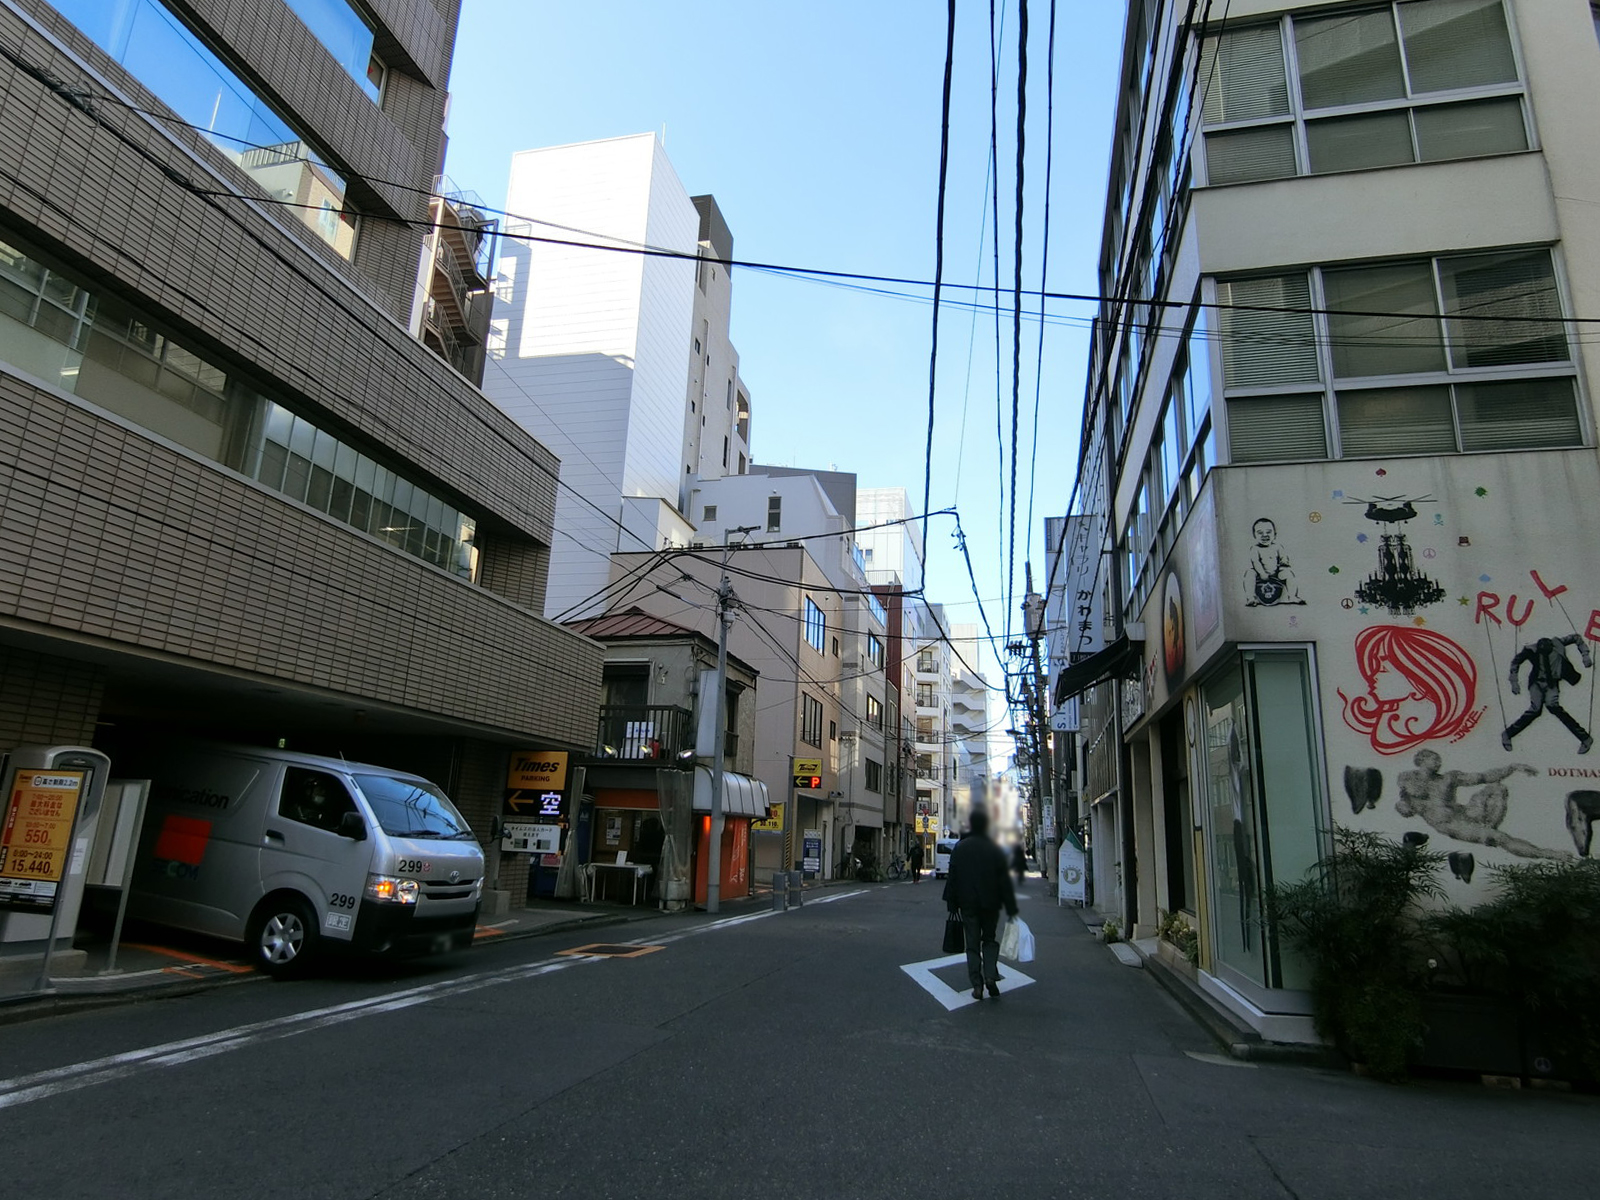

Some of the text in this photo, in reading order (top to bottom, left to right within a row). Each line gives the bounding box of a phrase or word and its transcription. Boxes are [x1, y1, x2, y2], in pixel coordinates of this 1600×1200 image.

[514, 757, 560, 773] Times
[811, 777, 820, 788] P
[539, 791, 562, 815] 空
[398, 859, 423, 873] 299
[330, 892, 356, 909] 299
